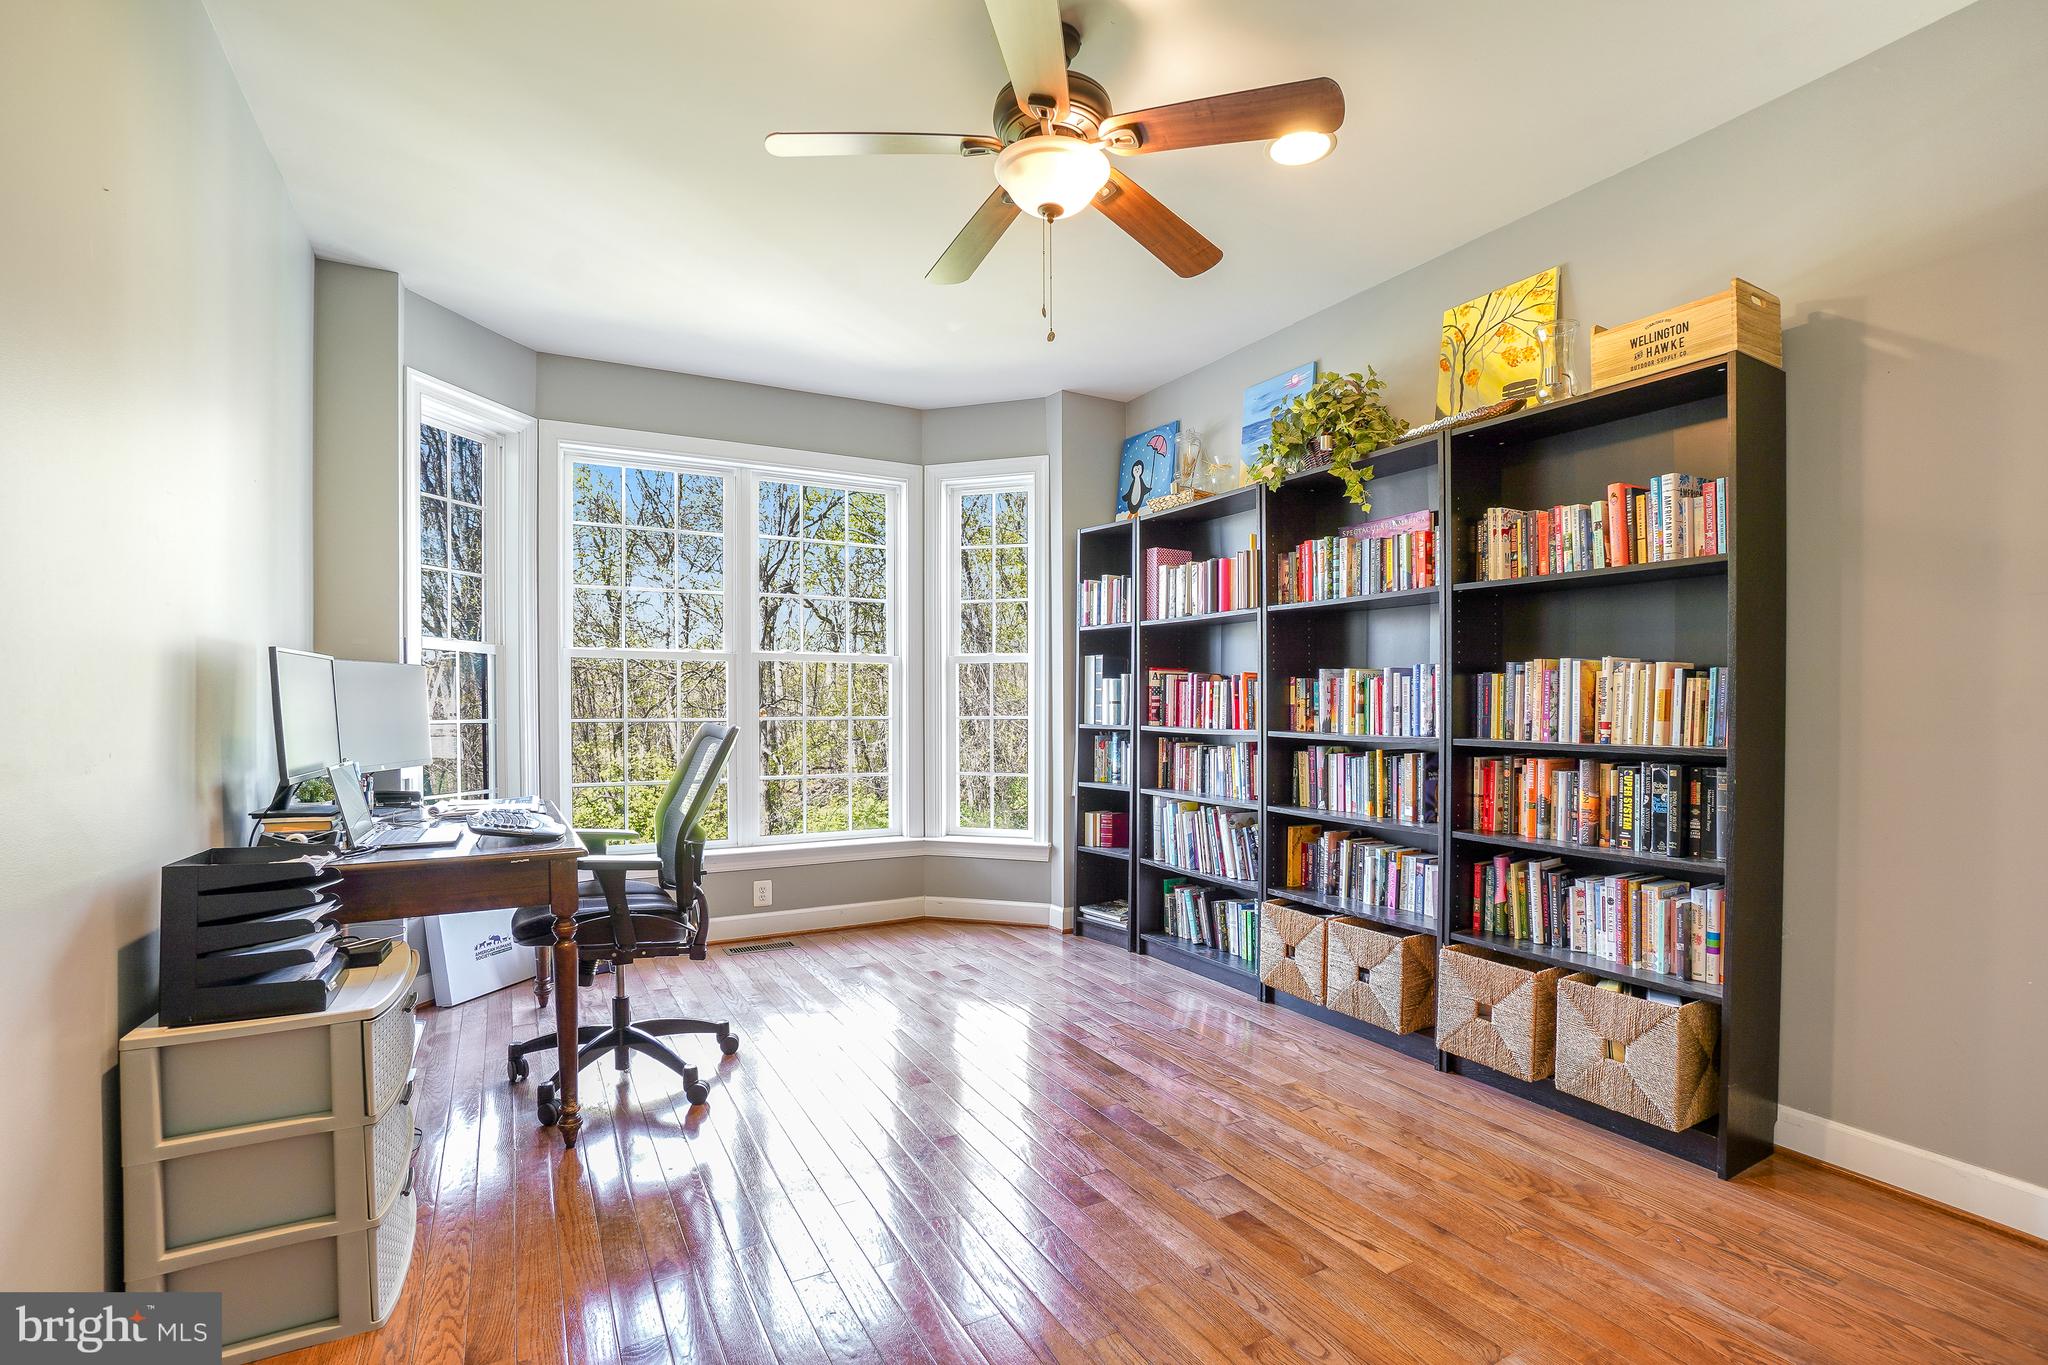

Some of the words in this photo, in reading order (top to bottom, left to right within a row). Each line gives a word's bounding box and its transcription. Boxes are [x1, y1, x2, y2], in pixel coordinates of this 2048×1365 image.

[1629, 321, 1689, 349] WELLINGTON
[1646, 336, 1685, 358] HAWKE
[1630, 359, 1655, 371] OUTDOOR
[1656, 353, 1677, 364] SUPPLY
[1664, 495, 1672, 531] AMERICAN
[1342, 523, 1389, 537] SPECTACULAR
[1391, 516, 1426, 528] AMERICA
[1504, 801, 1509, 810] WE
[1622, 797, 1634, 830] SYSTEM
[475, 948, 496, 956] AMERICAN
[475, 953, 493, 961] SOCIETY
